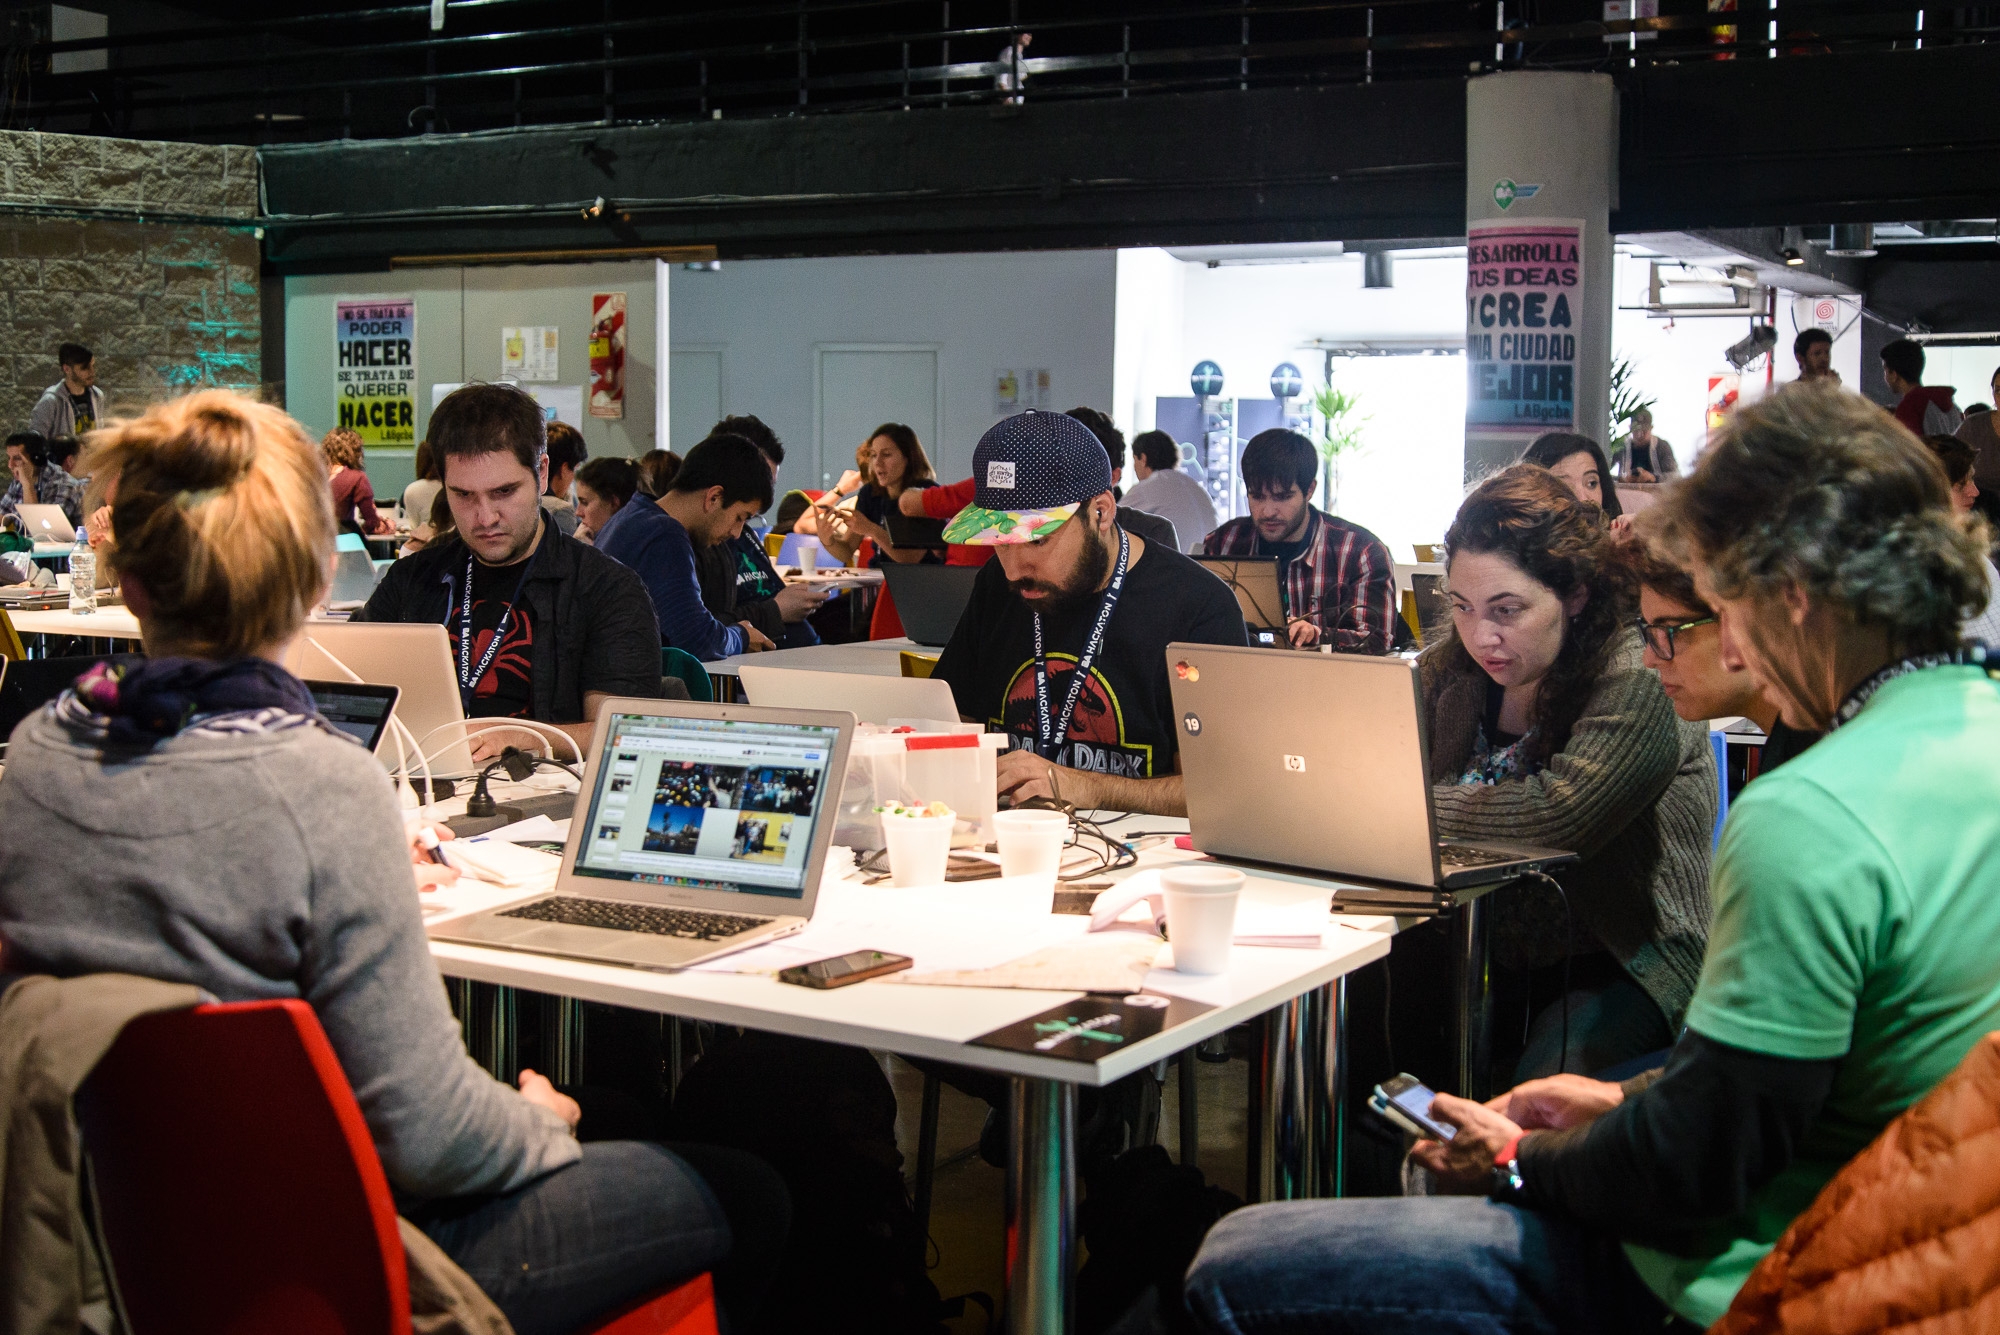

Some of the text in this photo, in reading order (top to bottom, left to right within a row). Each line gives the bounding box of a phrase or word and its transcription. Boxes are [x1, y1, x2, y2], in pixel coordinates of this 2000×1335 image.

[1469, 267, 1578, 288] TUS IDEAS
[369, 307, 394, 319] TRATA
[1479, 291, 1572, 329] CREA
[350, 320, 402, 335] PODER
[339, 338, 411, 367] HACER
[1500, 333, 1575, 361] CIUDAD
[338, 369, 414, 382] SE TRATA DE
[344, 382, 408, 399] QUERER
[339, 400, 413, 428] HACER
[463, 574, 472, 617] HACKATON
[1034, 611, 1042, 657] ACKATON
[1086, 602, 1113, 655] HACKATON
[461, 639, 470, 683] HACKATON
[476, 634, 502, 677] HACKATON
[1039, 686, 1050, 740] HACKATON
[1058, 679, 1082, 733] HACKATON
[1185, 718, 1199, 731] 19
